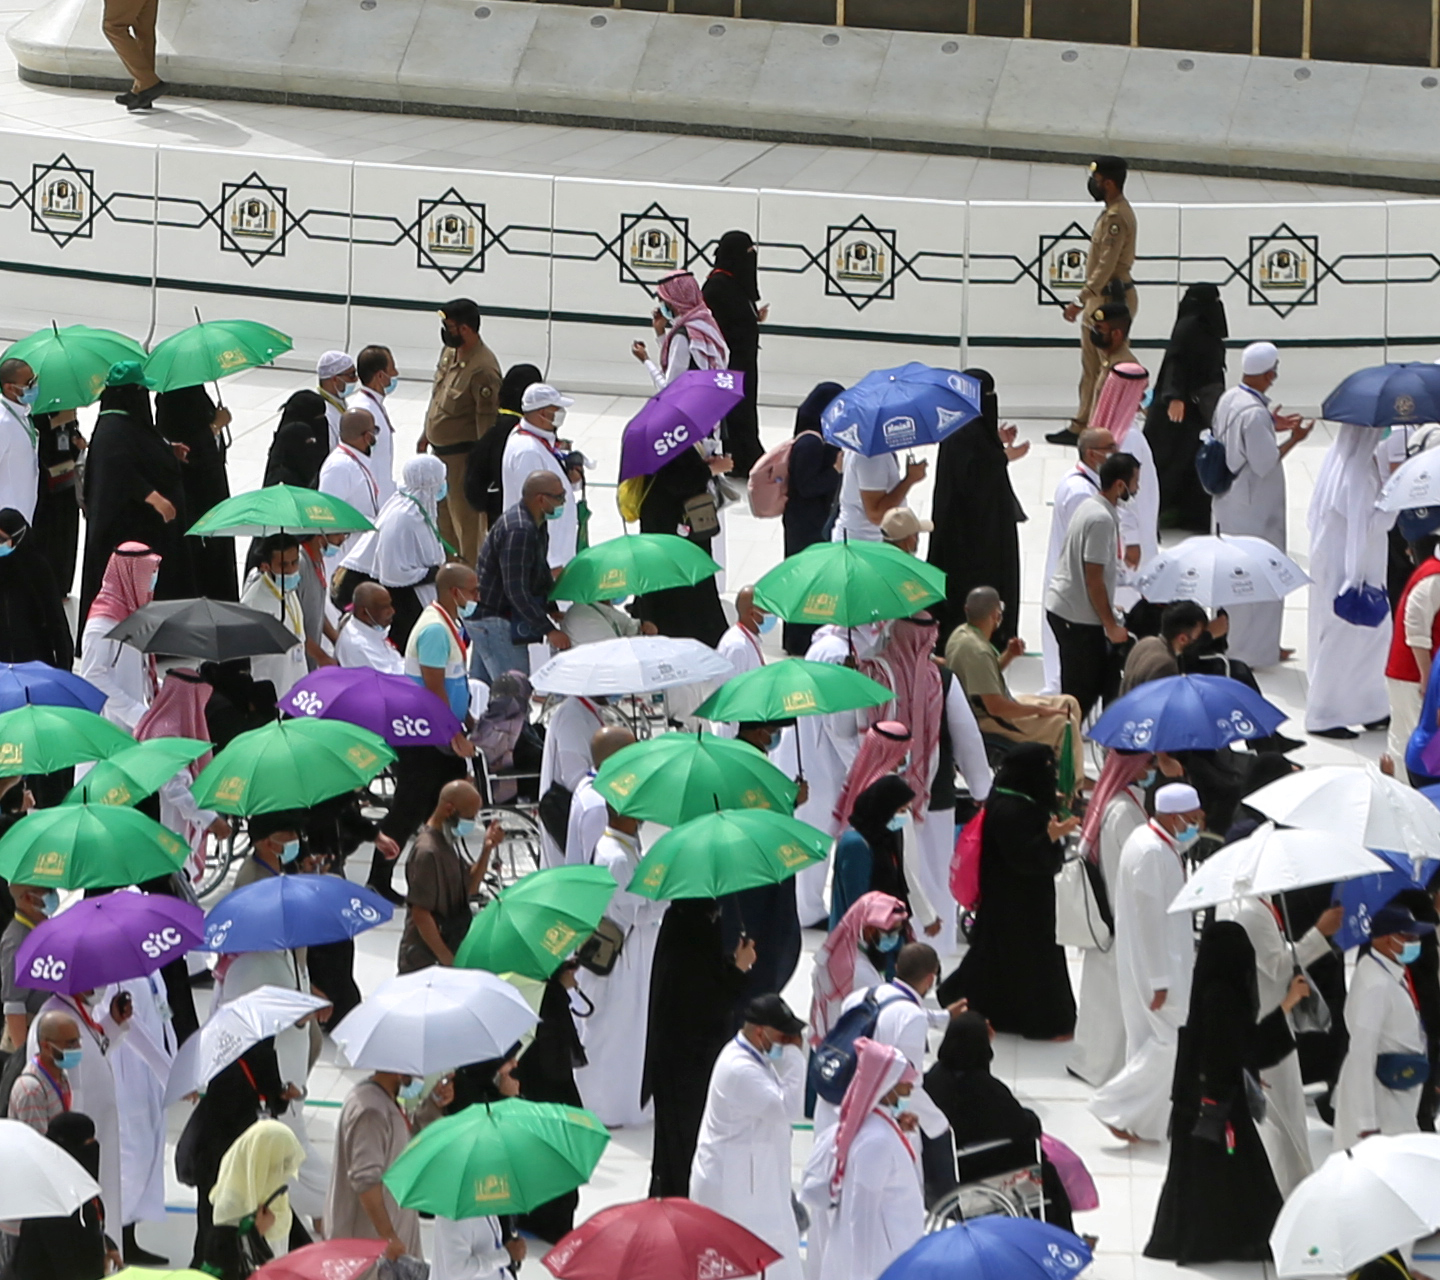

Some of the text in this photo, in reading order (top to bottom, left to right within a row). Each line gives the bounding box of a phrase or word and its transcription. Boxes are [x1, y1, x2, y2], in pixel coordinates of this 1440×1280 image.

[653, 424, 689, 455] stc
[292, 689, 324, 715] stc
[392, 713, 431, 737] stc
[142, 927, 181, 958] stc
[31, 953, 66, 980] stc
